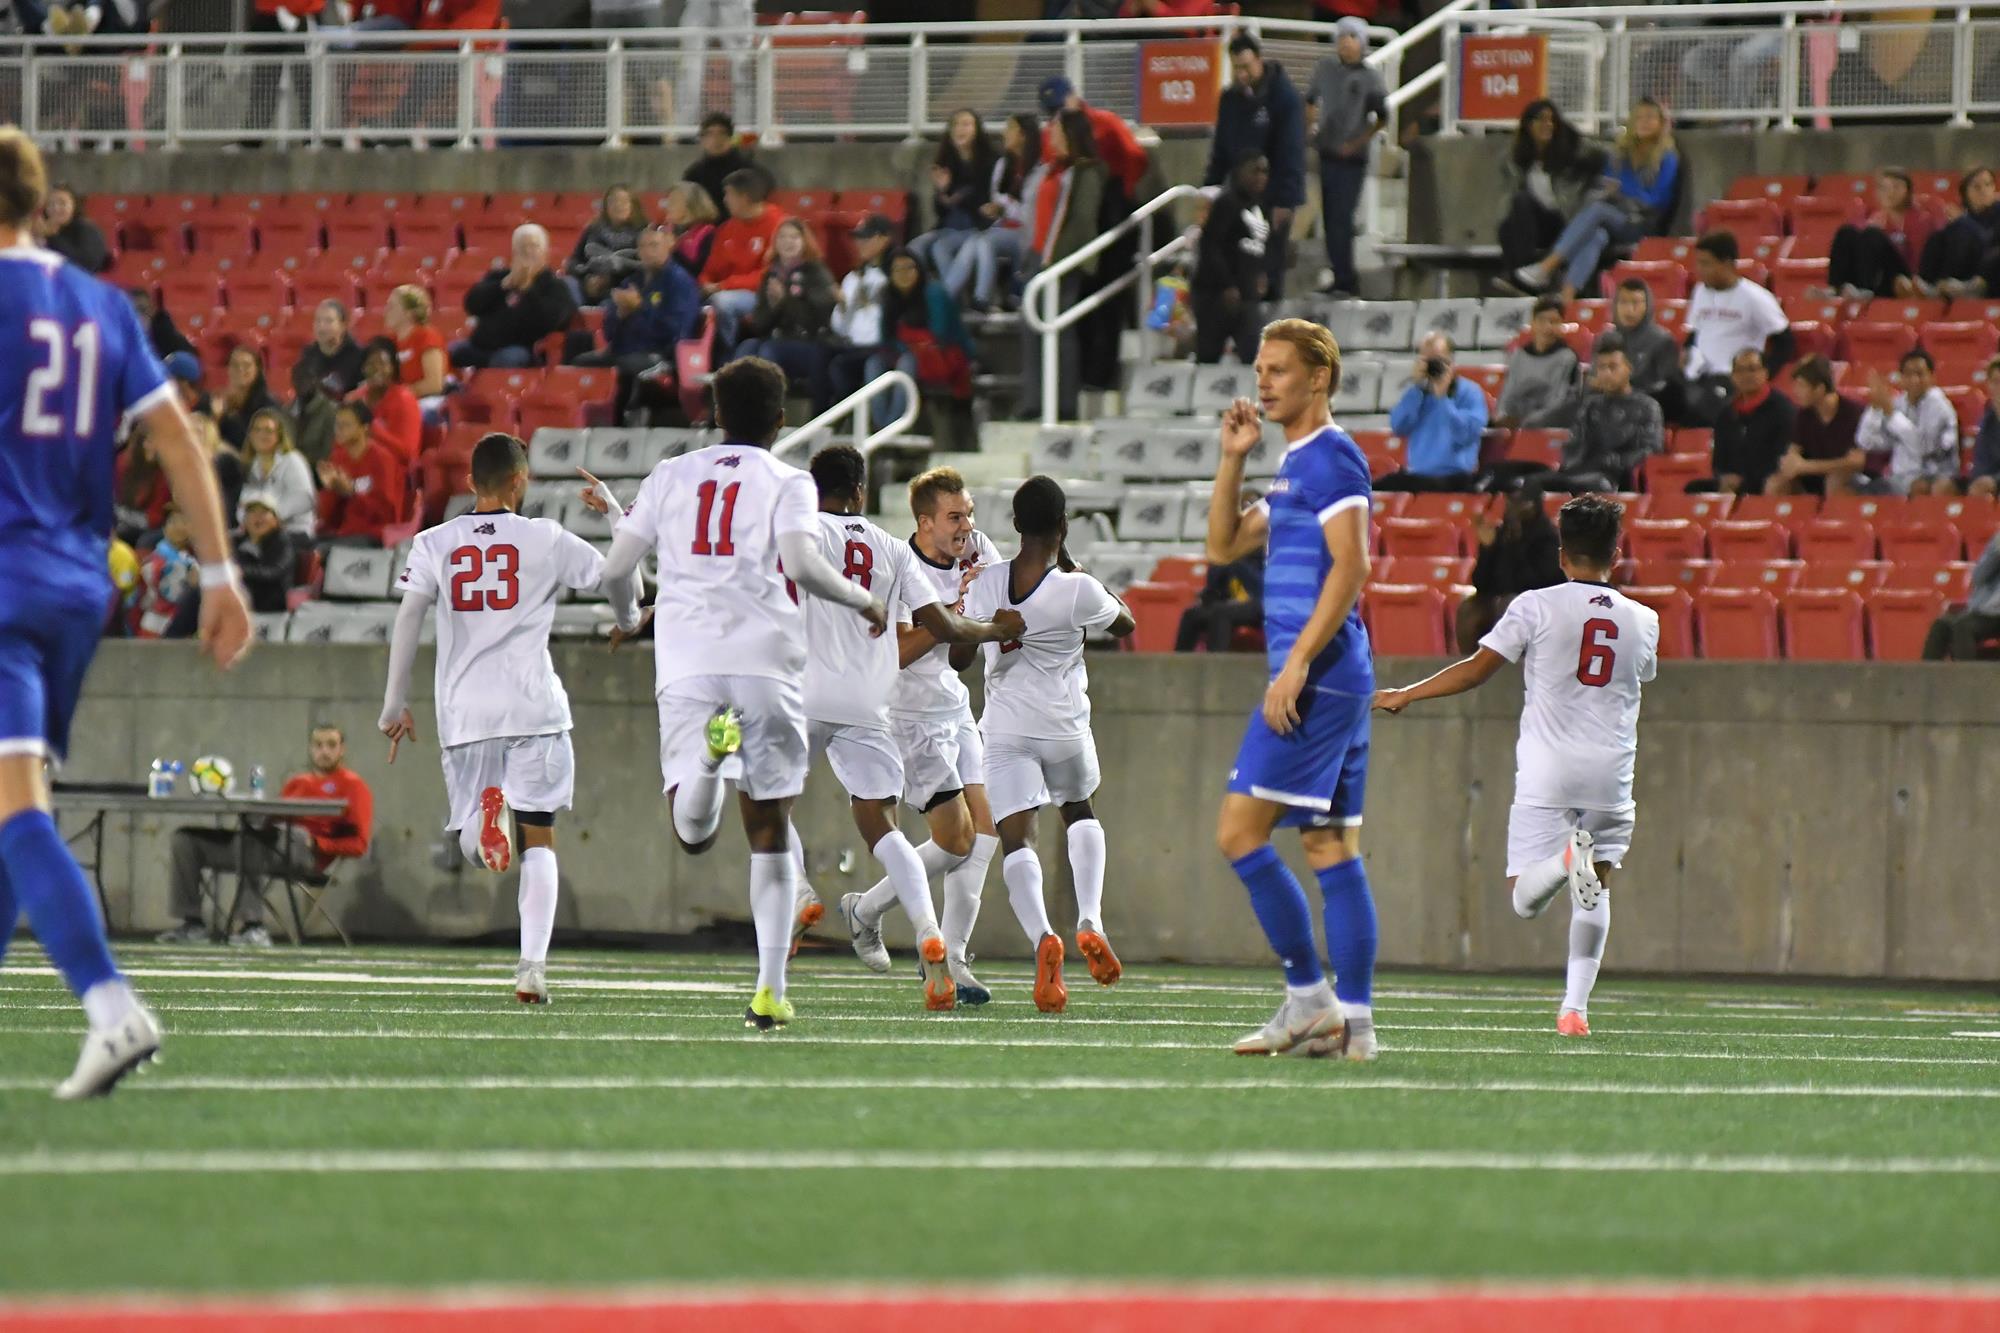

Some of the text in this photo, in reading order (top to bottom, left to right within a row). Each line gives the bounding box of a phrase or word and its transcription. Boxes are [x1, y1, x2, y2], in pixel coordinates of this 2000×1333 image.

[1150, 54, 1209, 73] SECTION
[1470, 50, 1534, 67] SECTION
[1161, 80, 1196, 102] 103
[1482, 73, 1519, 96] 104
[22, 318, 97, 437] 21
[691, 479, 741, 556] 11
[450, 544, 519, 611] 23
[1577, 617, 1619, 687] 6
